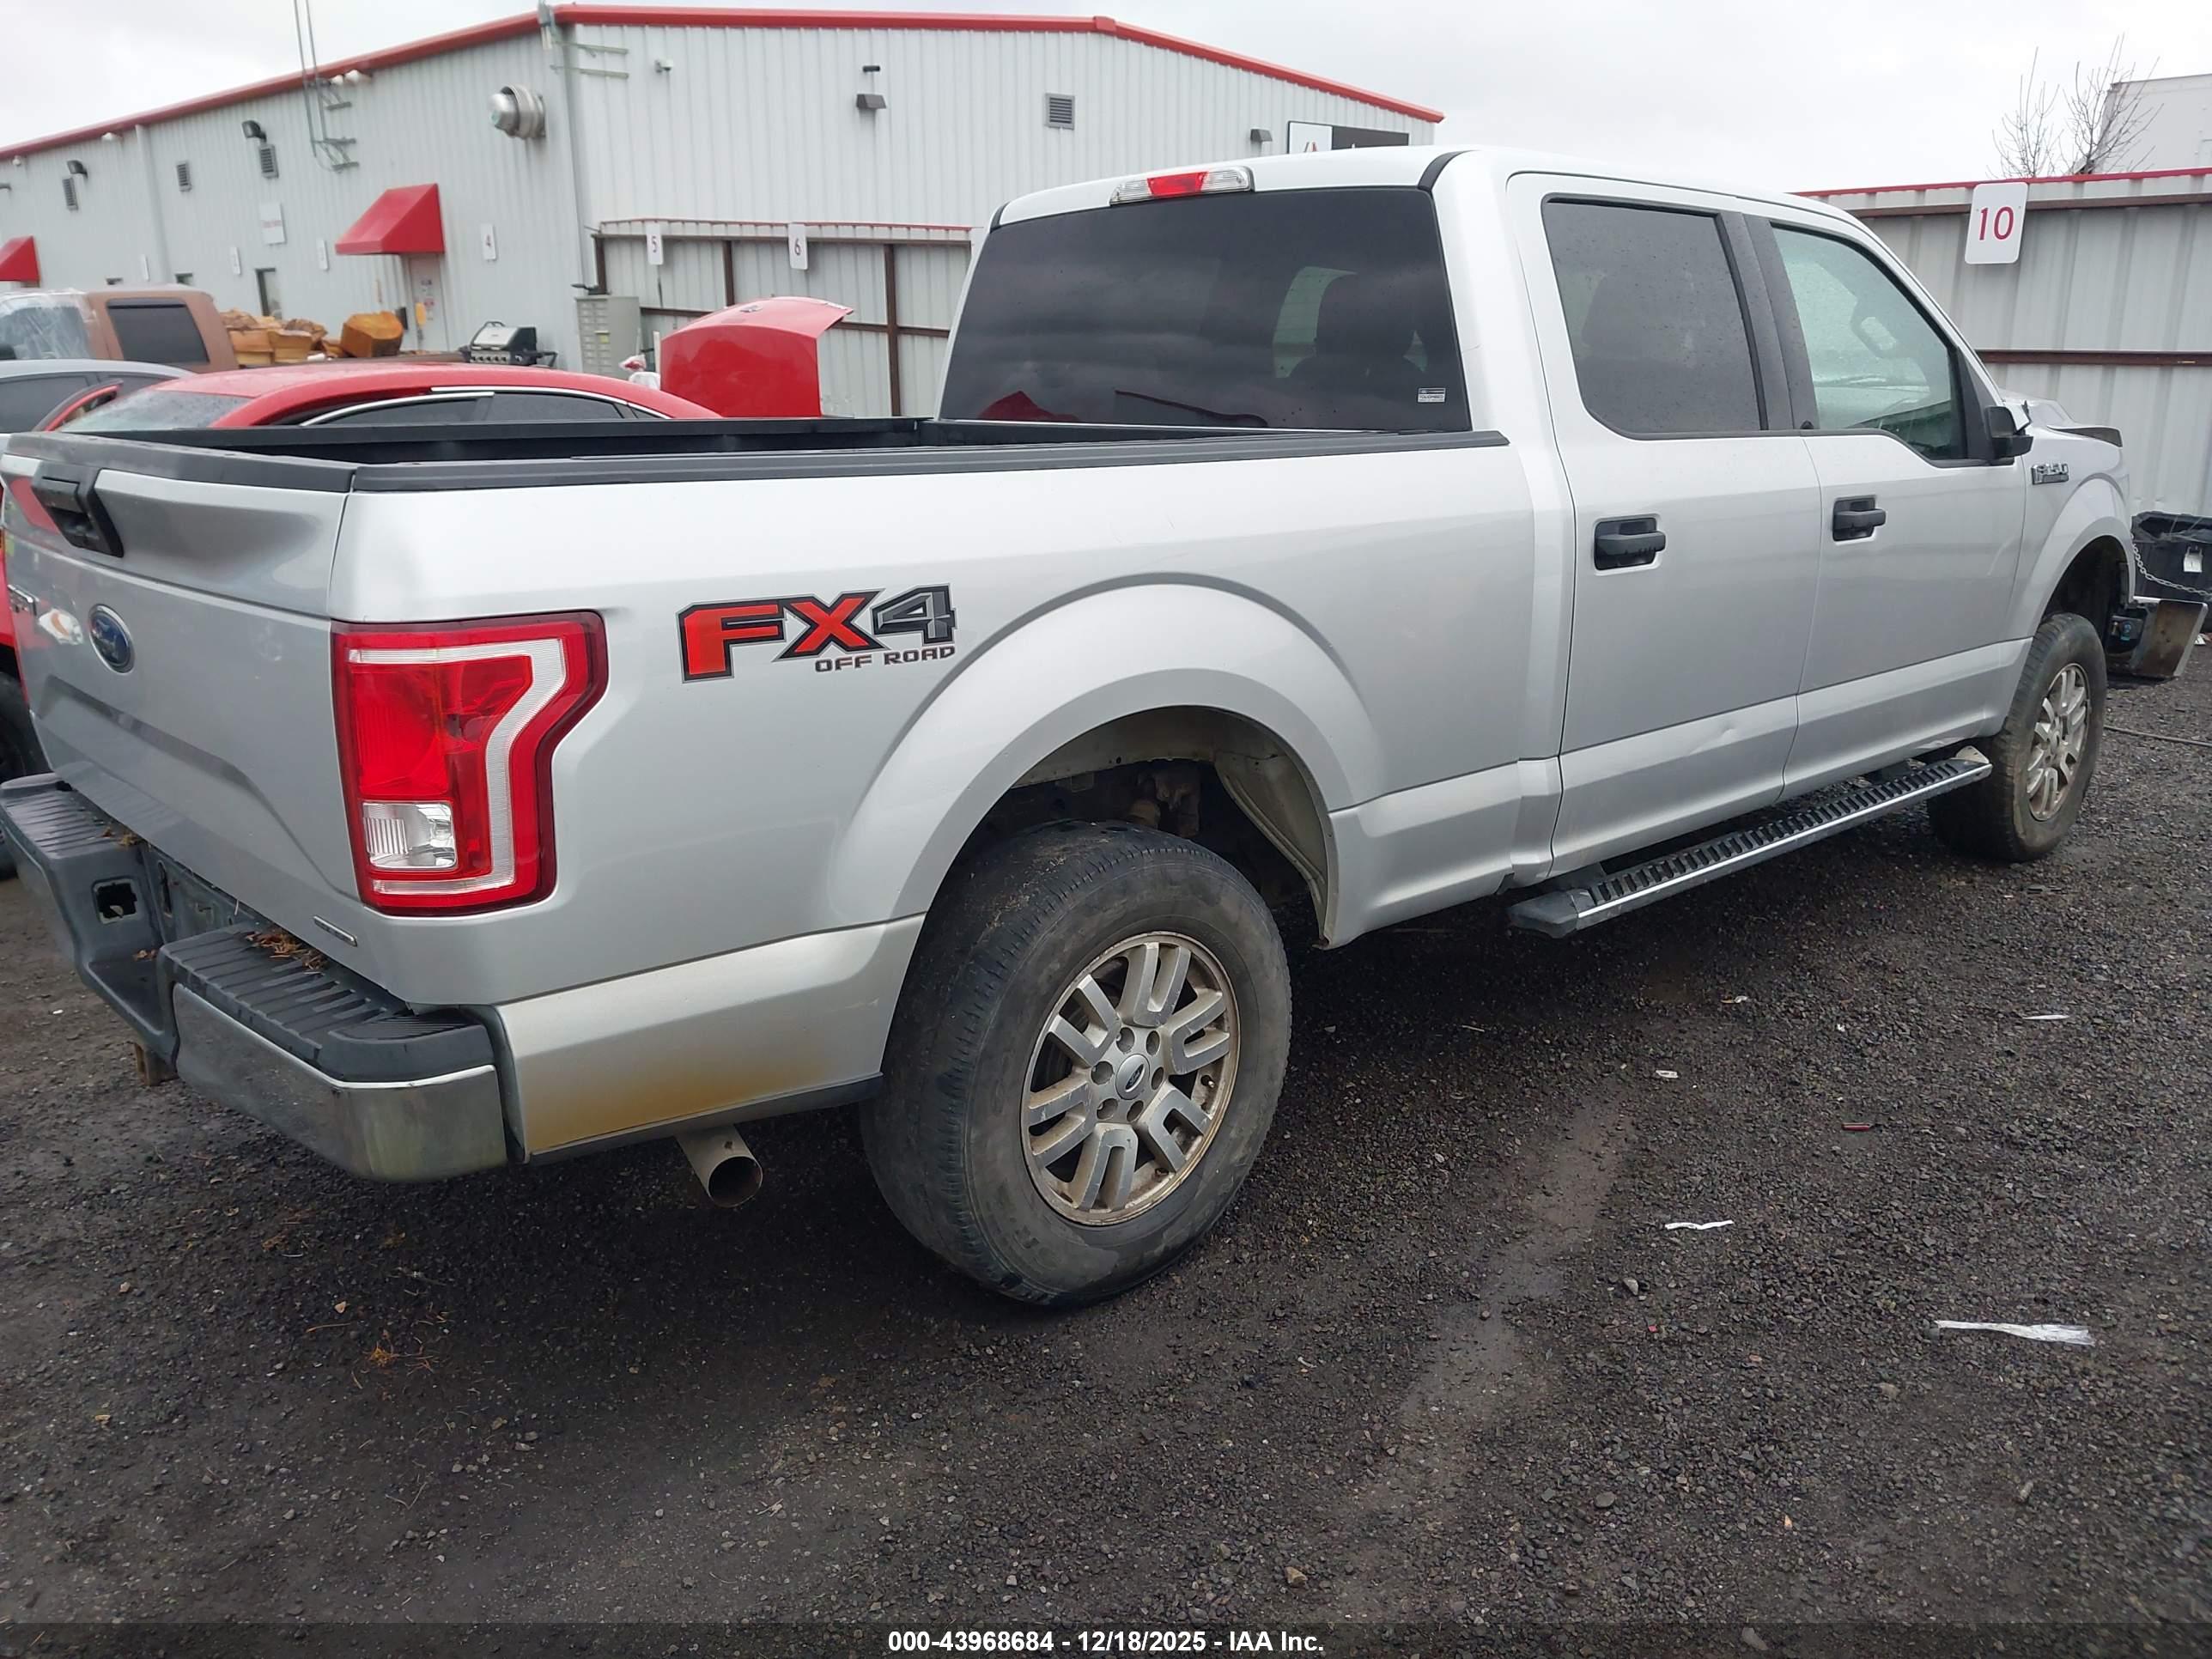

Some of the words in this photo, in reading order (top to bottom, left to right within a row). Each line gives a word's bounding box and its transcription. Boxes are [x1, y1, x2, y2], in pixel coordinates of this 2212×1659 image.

[1978, 206, 2014, 241] 10
[651, 235, 659, 253] 5
[794, 238, 802, 256] 6
[676, 582, 958, 684] FX4
[814, 653, 873, 673] OFF
[883, 644, 957, 666] ROAD
